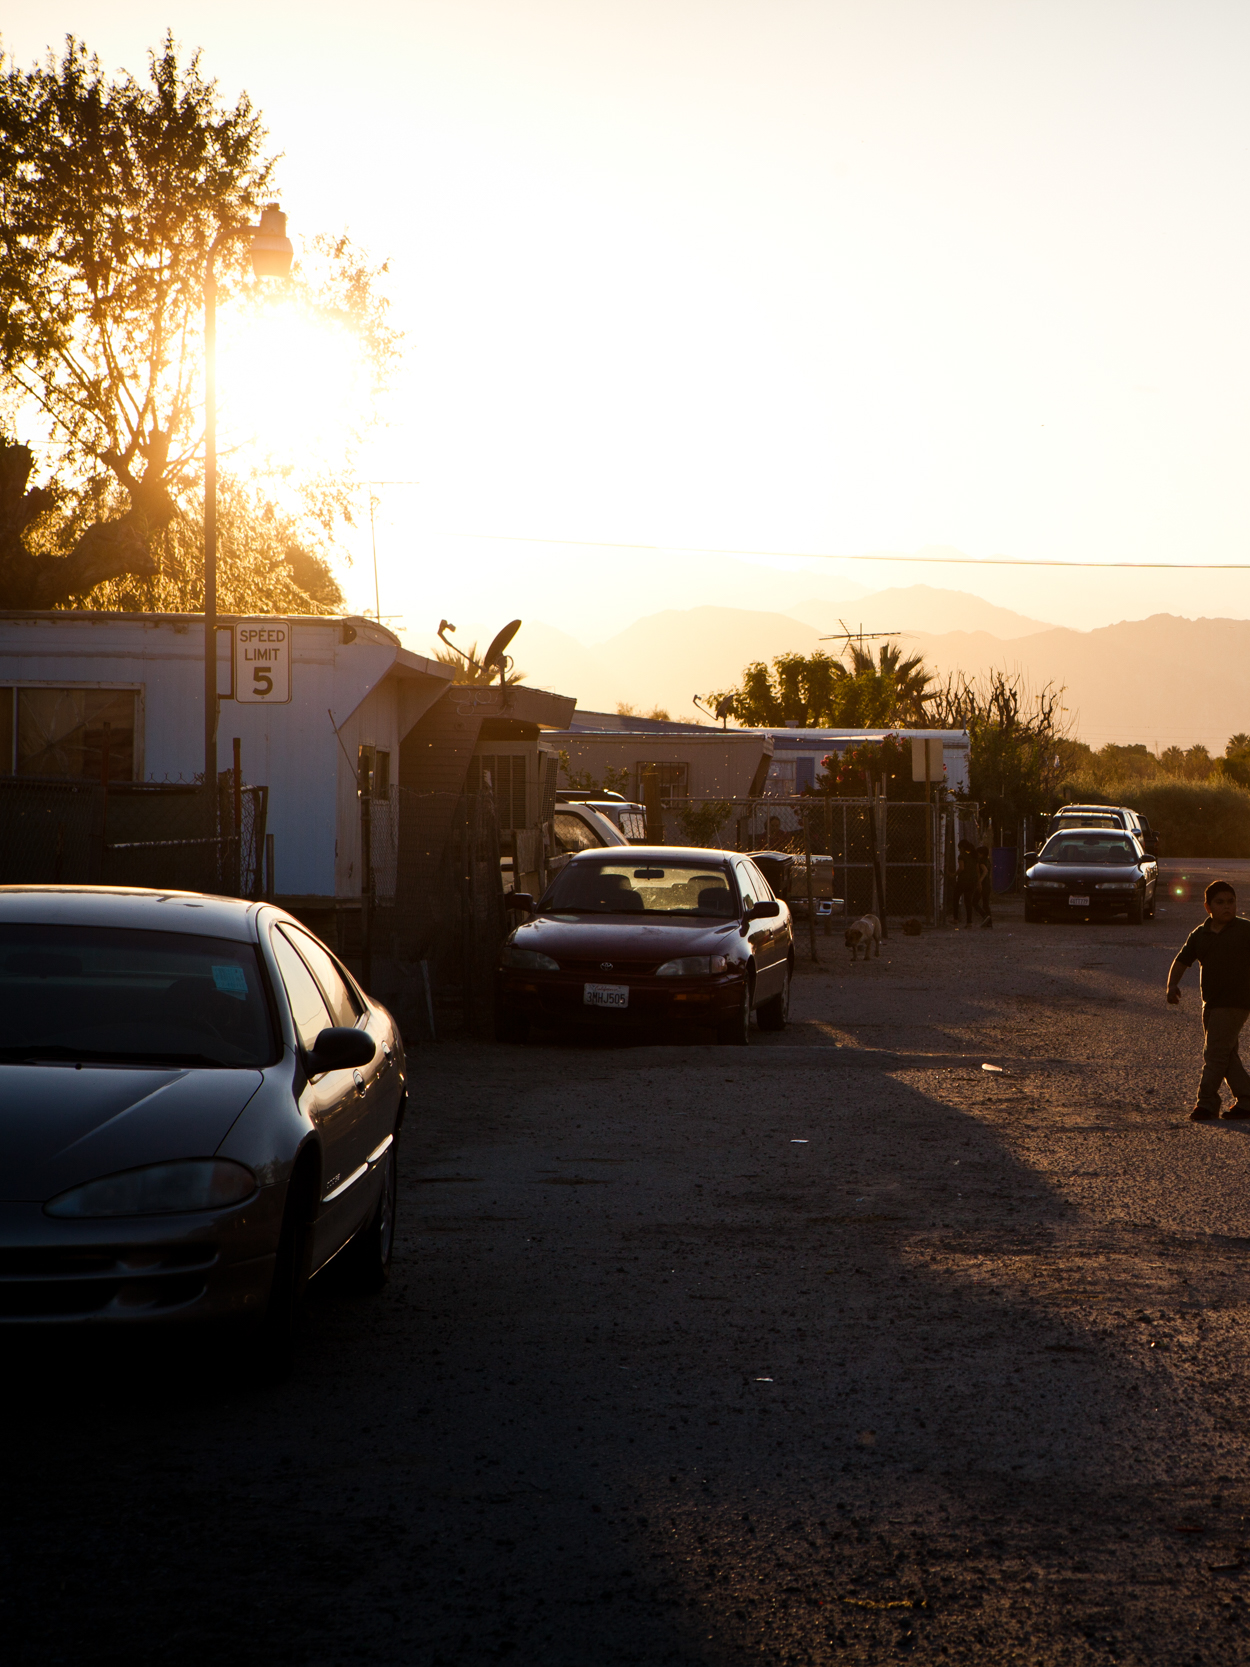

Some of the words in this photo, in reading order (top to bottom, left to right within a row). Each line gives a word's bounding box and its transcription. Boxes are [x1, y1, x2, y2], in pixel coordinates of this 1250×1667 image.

[239, 629, 285, 642] SPEED
[244, 648, 280, 661] LIMIT
[252, 666, 273, 696] 5
[586, 991, 626, 1004] 3MHJ505
